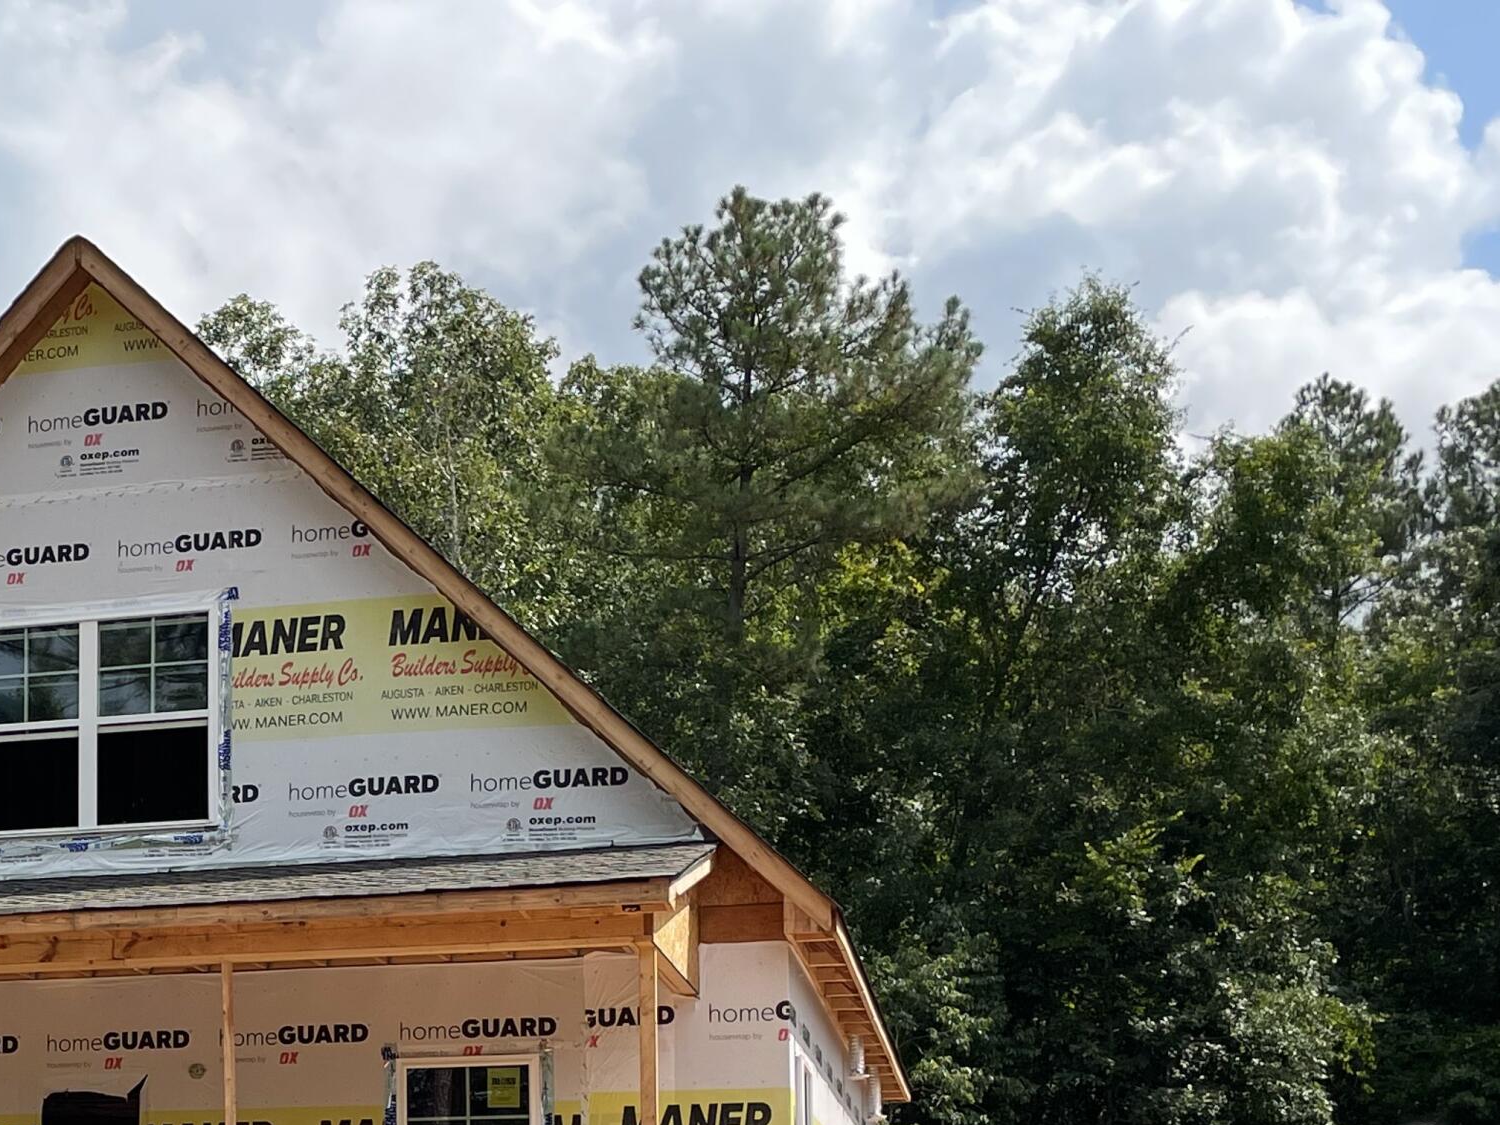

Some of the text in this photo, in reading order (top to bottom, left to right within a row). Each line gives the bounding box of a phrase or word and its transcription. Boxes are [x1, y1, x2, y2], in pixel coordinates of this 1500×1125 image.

[28, 402, 168, 434] homeGUARD
[84, 433, 103, 447] OX
[80, 447, 140, 462] oxep.com
[291, 519, 369, 543] homeG
[117, 528, 262, 558] homeGUARD
[352, 544, 371, 557] OX
[176, 559, 194, 572] OX
[7, 572, 26, 585] OX
[278, 657, 364, 691] Supply Co.
[391, 649, 519, 681] Builders Supply
[381, 680, 538, 701] AUGUSTA AIKEN CHARLESTON
[255, 691, 353, 709] AIKEN CHARLESTON
[435, 700, 528, 718] MANER.COM
[255, 711, 343, 730] MANER.COM
[288, 774, 440, 801] homeGUARD
[470, 766, 629, 793] homeGUARD
[348, 804, 368, 818] OX
[532, 797, 555, 810] OX
[345, 822, 409, 834] oxep.com
[529, 815, 596, 826] oxep.com
[708, 1000, 792, 1024] homeG
[400, 1016, 558, 1041] homeGUARD
[46, 1030, 190, 1053] homeGUARD
[104, 1057, 123, 1070] OX
[279, 1051, 299, 1065] OX
